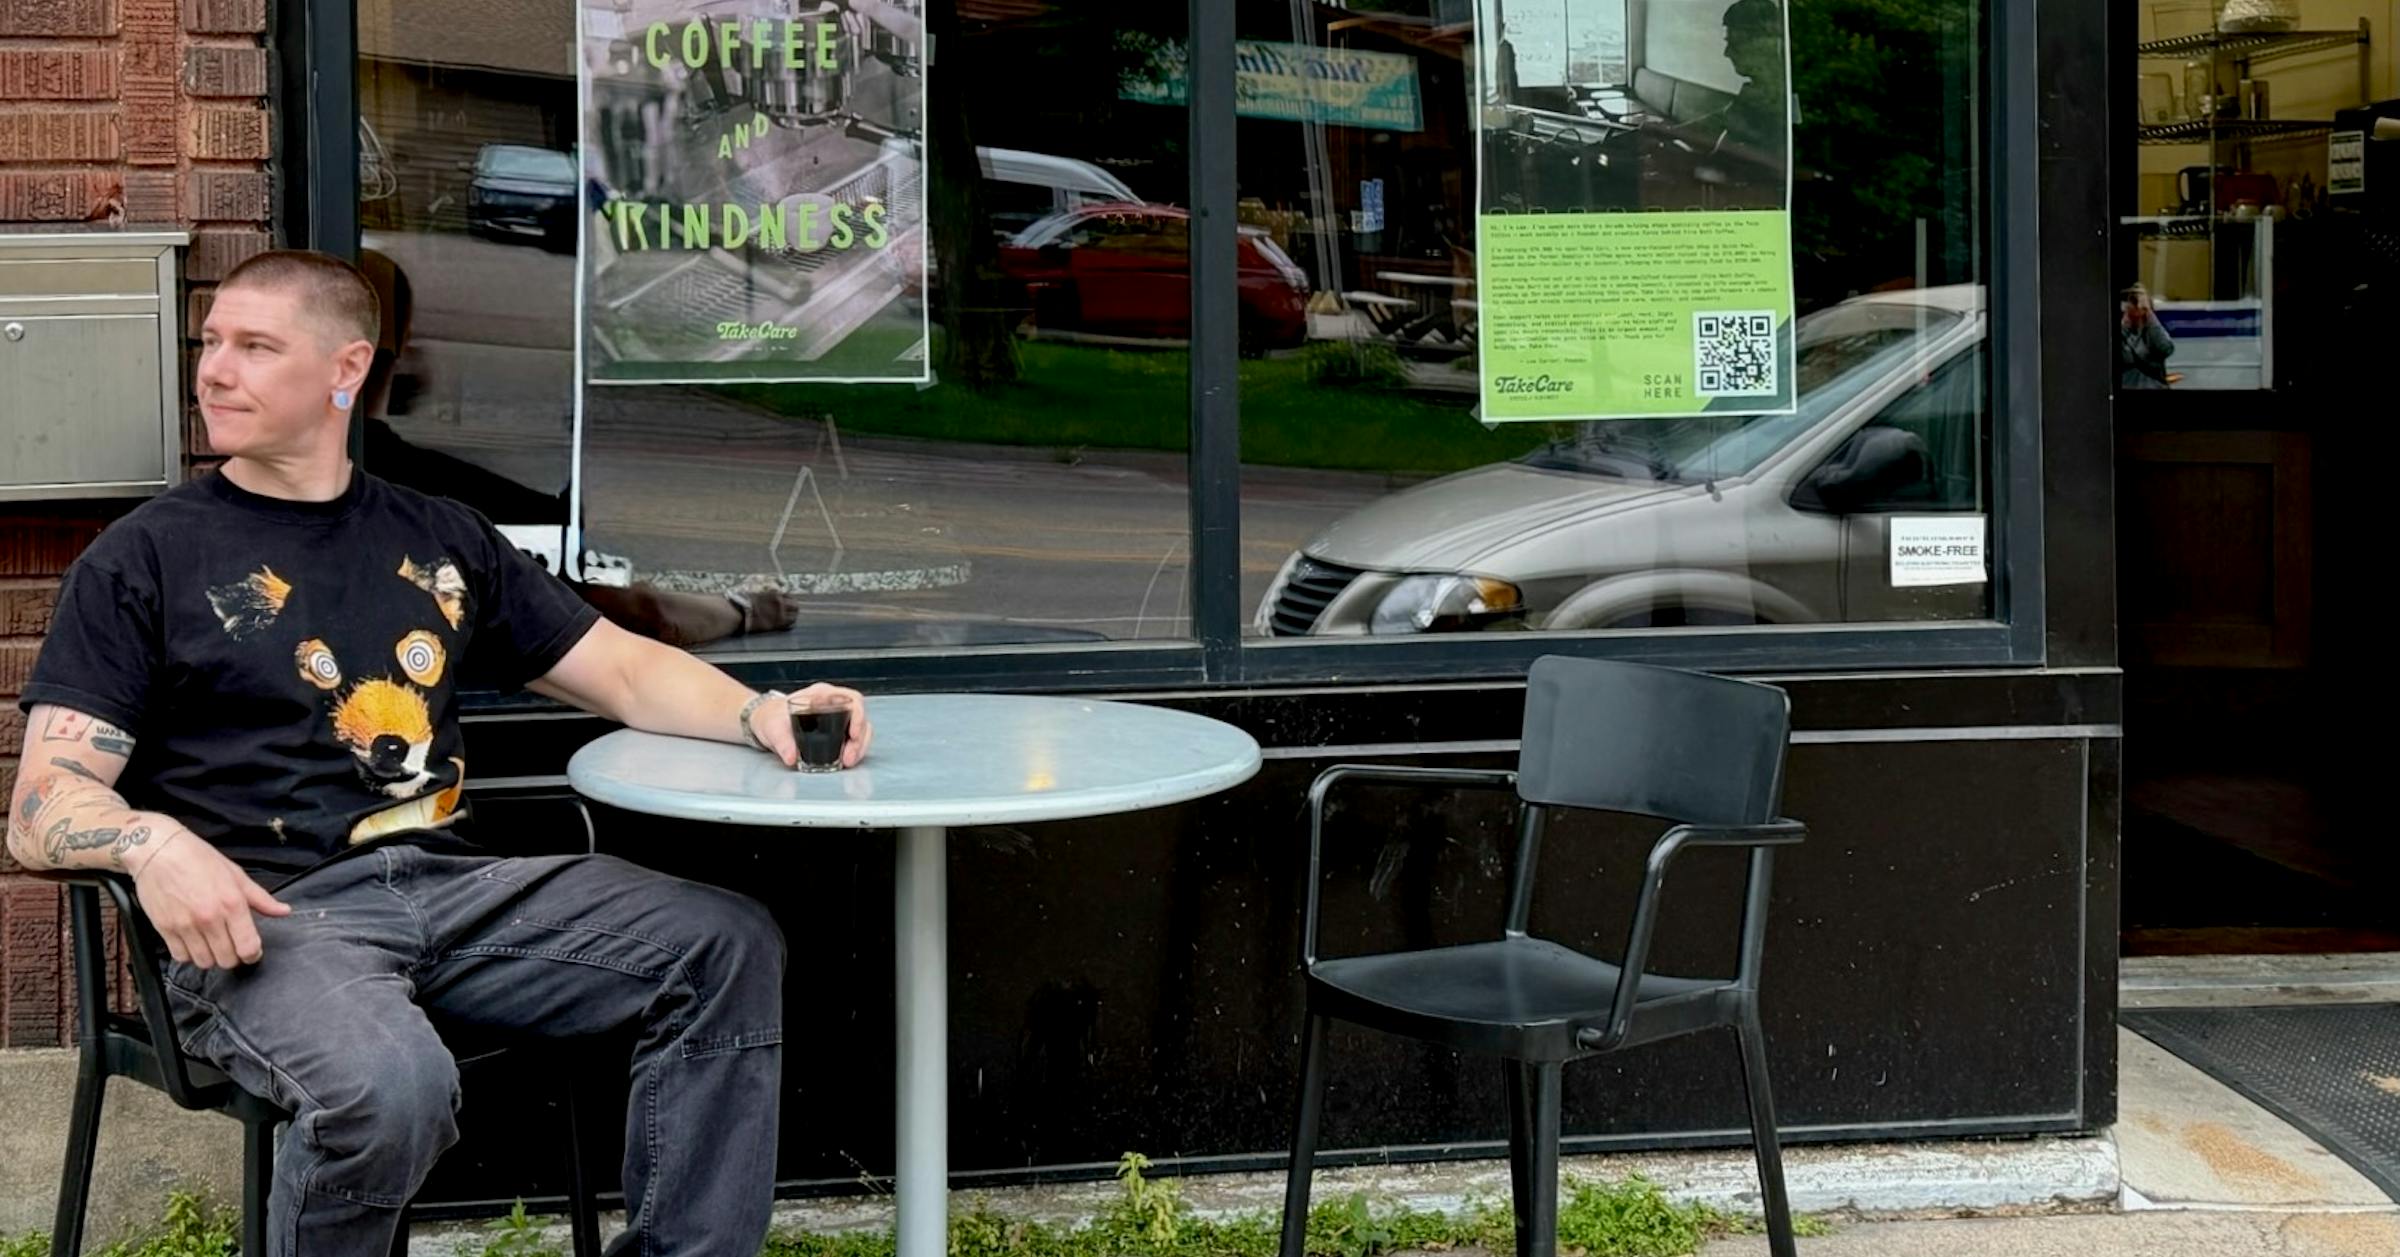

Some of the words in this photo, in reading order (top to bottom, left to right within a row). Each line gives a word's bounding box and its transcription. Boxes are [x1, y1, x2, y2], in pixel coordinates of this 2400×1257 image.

[646, 22, 838, 69] COFFEE
[718, 113, 769, 159] AND
[604, 202, 888, 250] KINDNESS
[1643, 374, 1682, 385] SCAN
[1643, 387, 1682, 399] HERE
[1897, 545, 1979, 556] SMOKE-FREE
